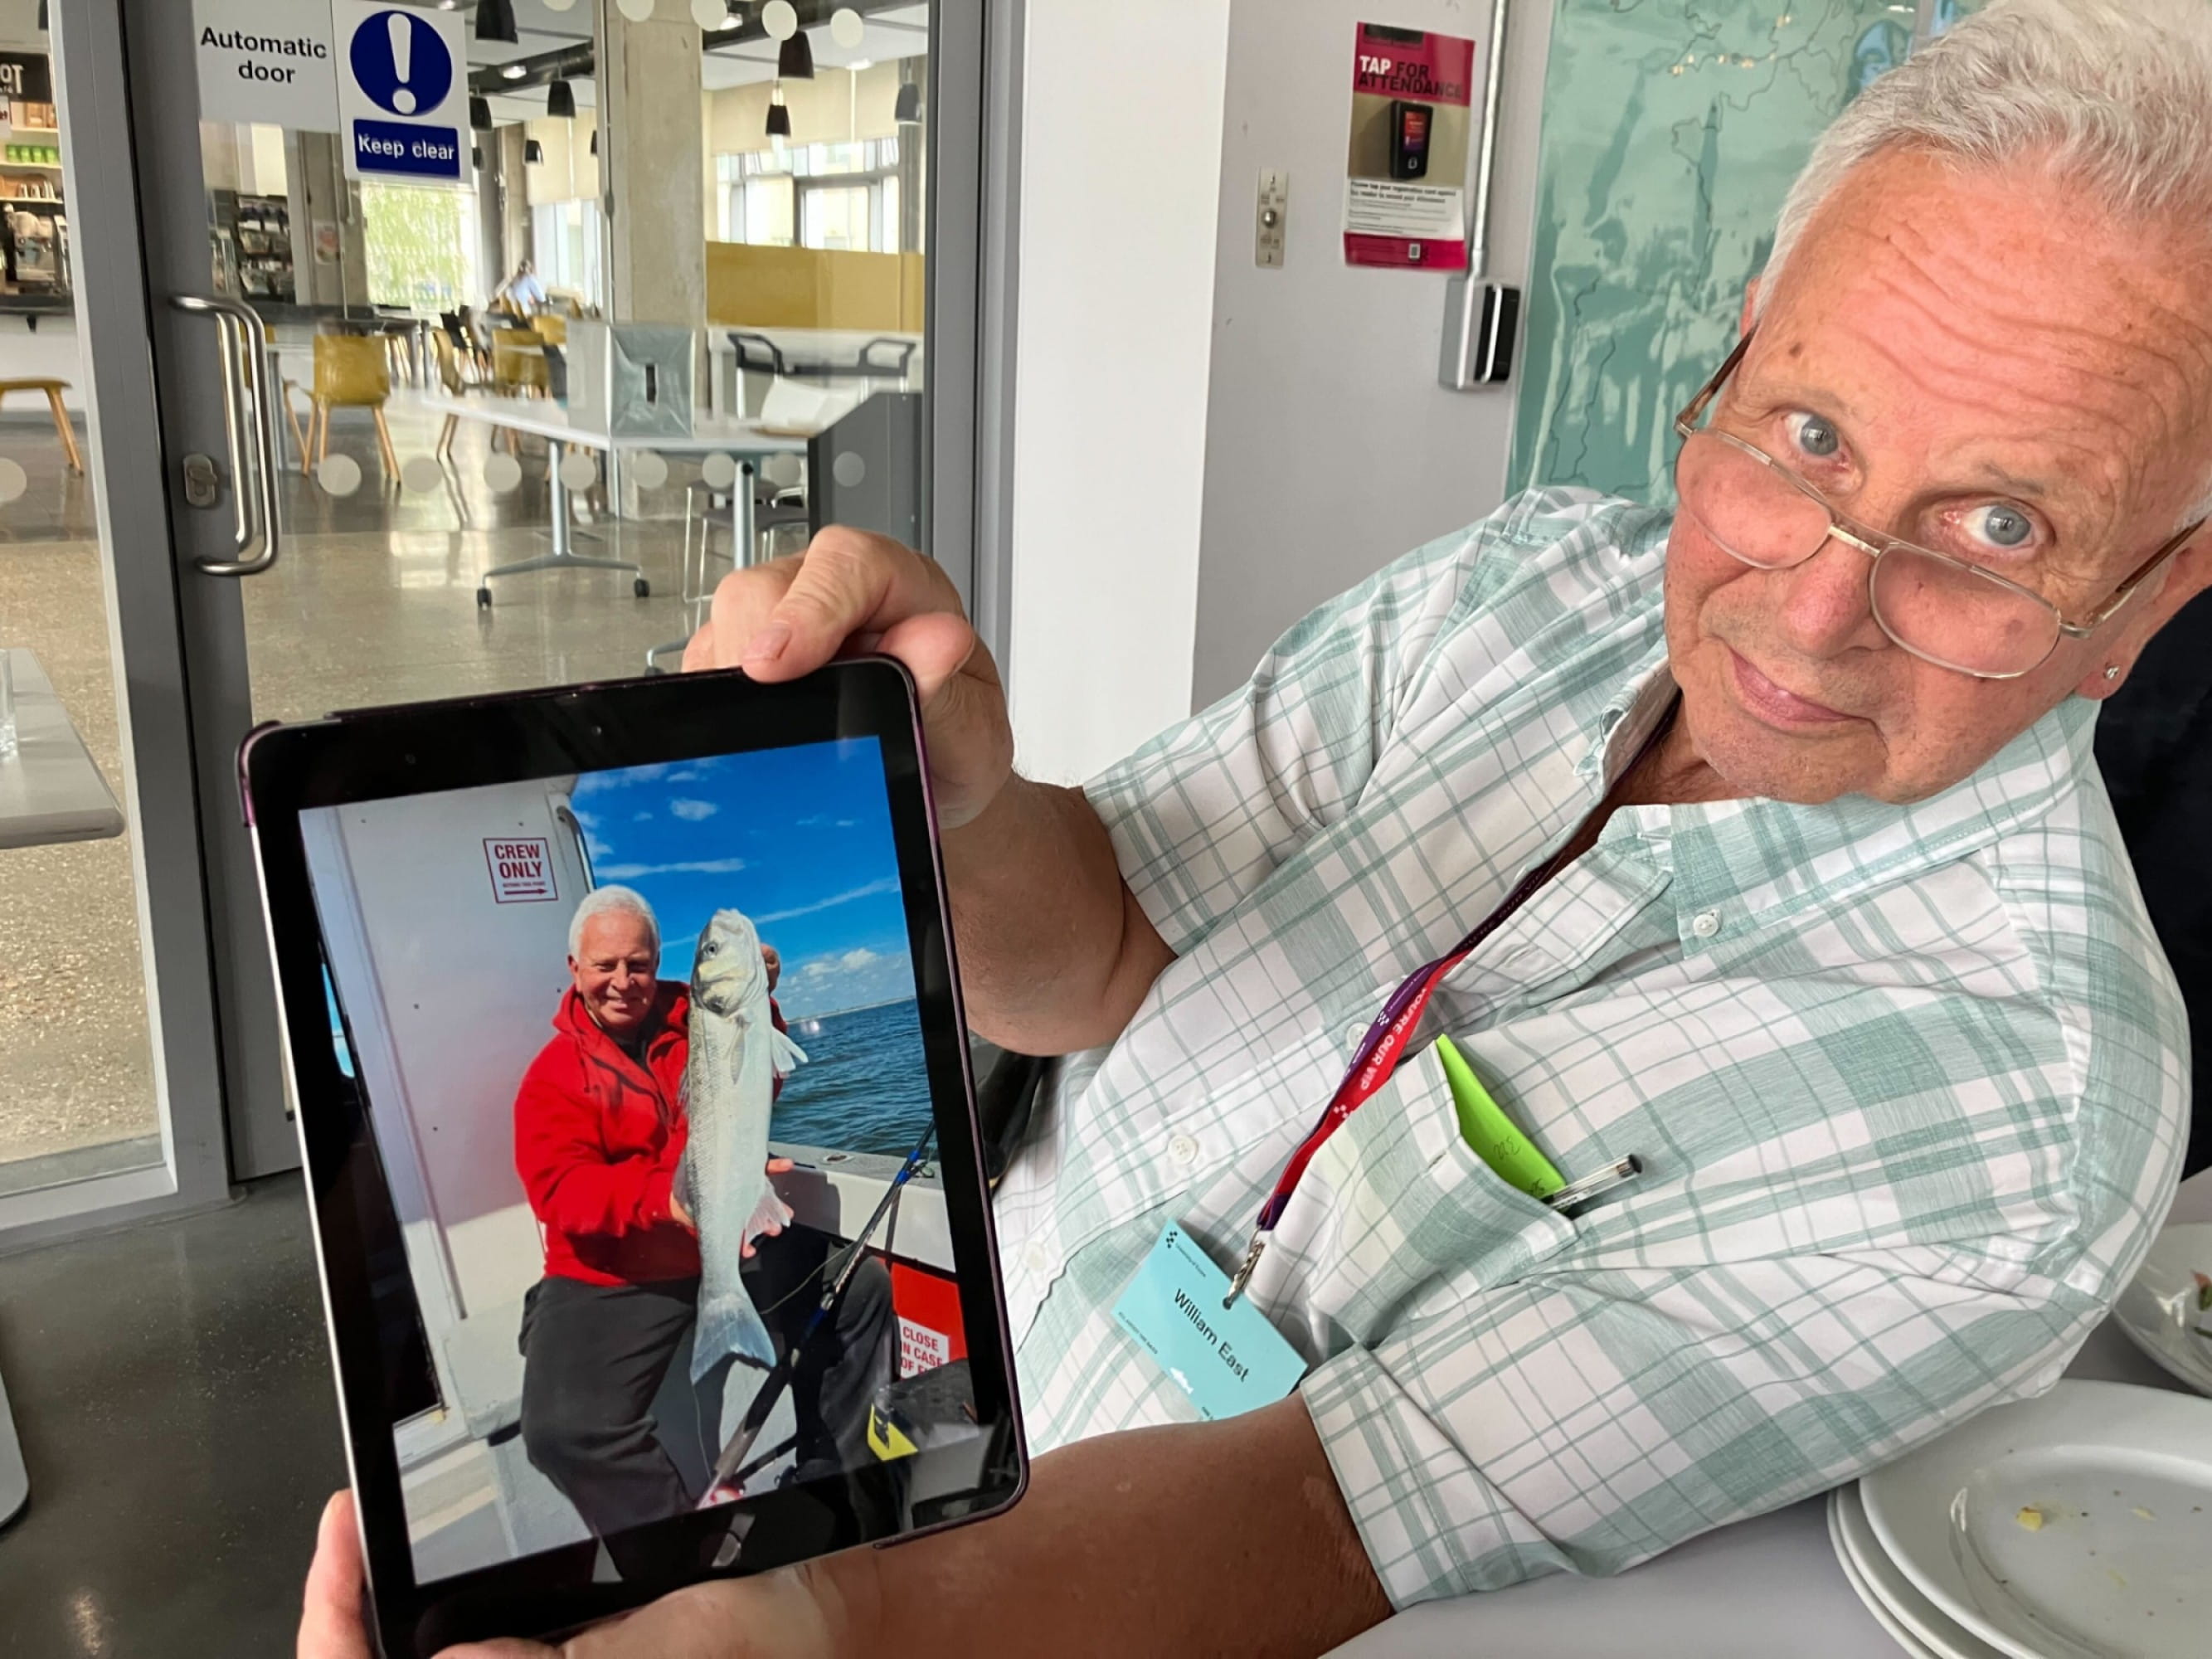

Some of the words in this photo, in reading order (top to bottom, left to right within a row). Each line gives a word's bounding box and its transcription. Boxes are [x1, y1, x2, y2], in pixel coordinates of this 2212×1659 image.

[201, 27, 327, 59] Automatic
[238, 60, 296, 83] door
[1359, 56, 1392, 75] TAP
[1397, 62, 1429, 78] FOR
[1359, 74, 1462, 99] ATTENDANCE
[358, 134, 404, 158] Keep
[412, 139, 455, 160] clear
[494, 844, 540, 859] CREW
[499, 861, 542, 878] ONLY
[1372, 1034, 1394, 1065] OUR
[1360, 1066, 1377, 1091] VIP
[903, 1326, 939, 1352] CLOSE
[1174, 1287, 1218, 1345] William
[1218, 1341, 1250, 1383] East
